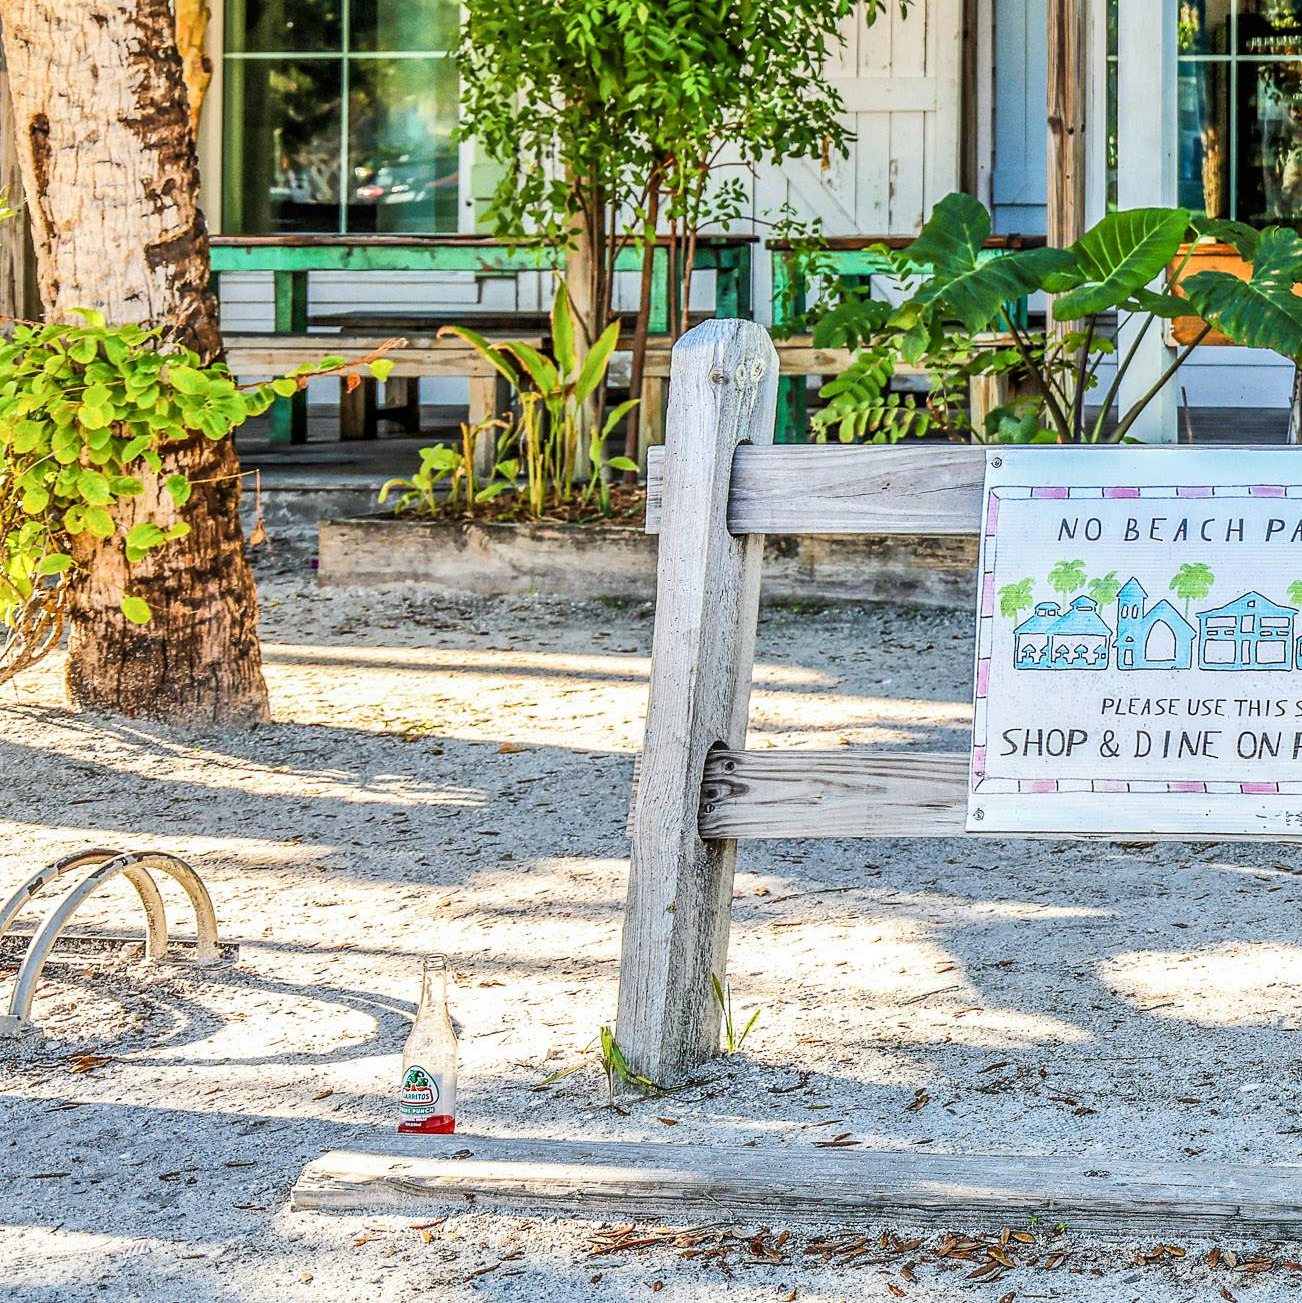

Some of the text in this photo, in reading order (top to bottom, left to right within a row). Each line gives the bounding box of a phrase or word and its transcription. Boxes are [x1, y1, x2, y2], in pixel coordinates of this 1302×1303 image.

[1058, 517, 1102, 541] NO
[1124, 517, 1244, 542] BEACH
[1101, 697, 1179, 716] PLEASE
[1188, 698, 1226, 716] USE
[1235, 698, 1287, 717] THIS
[1000, 728, 1088, 758] SHOP
[1100, 730, 1121, 757] &
[1134, 730, 1222, 759] DINE
[1236, 731, 1287, 760] ON
